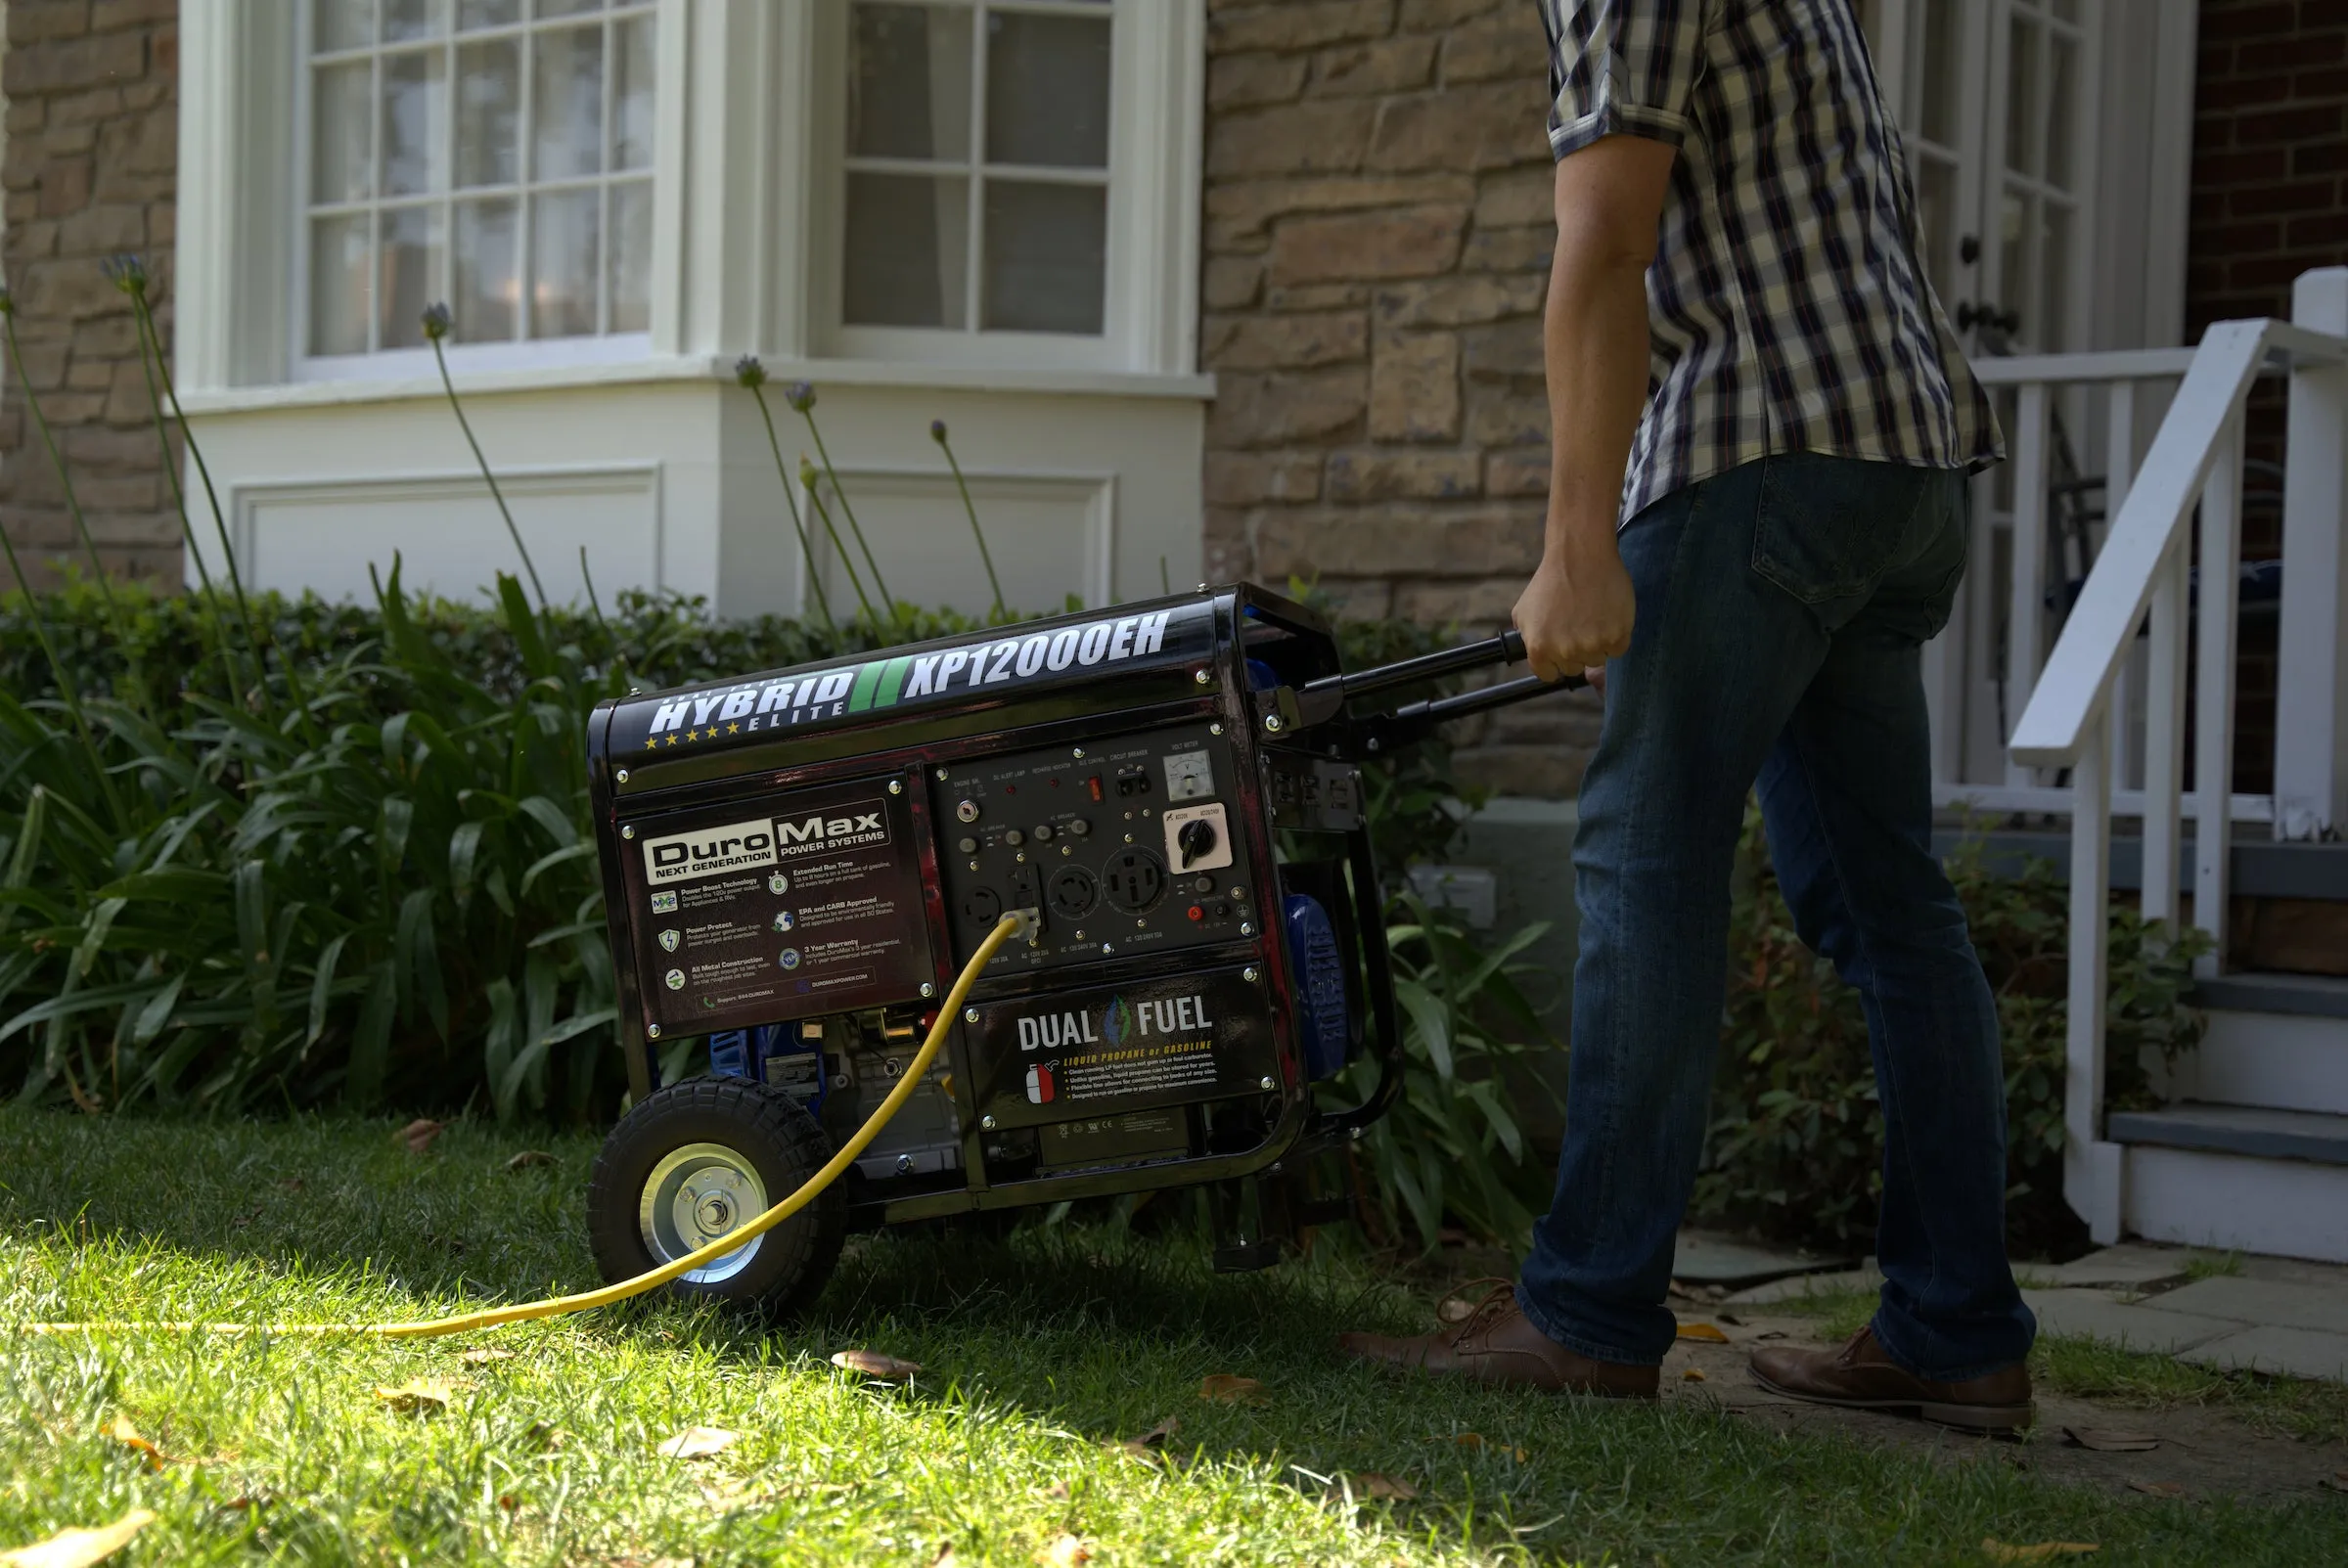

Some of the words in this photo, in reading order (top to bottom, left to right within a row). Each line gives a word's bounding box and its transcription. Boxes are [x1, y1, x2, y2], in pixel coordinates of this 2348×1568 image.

[650, 672, 853, 734] HYBRID
[904, 612, 1170, 698] XP12000EH
[747, 701, 843, 732] ELITE
[1109, 752, 1127, 761] CIRCUIT
[1128, 749, 1149, 759] BREAKER
[780, 842, 825, 857] POWER
[828, 830, 884, 848] SYSTEMS
[655, 865, 689, 877] NEXT
[692, 851, 771, 872] GENERATION
[793, 866, 823, 876] Extended
[681, 886, 701, 895] Power
[702, 883, 722, 892] Boost
[722, 877, 757, 890] Technology
[826, 902, 845, 911] CARB
[846, 896, 878, 909] Approved
[686, 925, 707, 934] Power
[707, 921, 733, 931] Protect
[827, 939, 858, 951] Warranty
[701, 963, 721, 971] Metal
[721, 956, 763, 968] Construction
[1017, 1009, 1099, 1051] DUAL
[1137, 995, 1212, 1036] FUEL
[1063, 1054, 1097, 1066] LIQUID
[1102, 1049, 1146, 1062] PROPANE
[1149, 1048, 1159, 1056] or
[1163, 1040, 1212, 1054] GASOLINE
[1069, 1075, 1087, 1084] Unlike
[1112, 1070, 1128, 1080] liquid
[1129, 1069, 1151, 1078] propane
[1171, 1062, 1190, 1071] stored
[1084, 1064, 1105, 1075] running
[1070, 1082, 1093, 1091] Flexible
[1131, 1074, 1162, 1085] connecting
